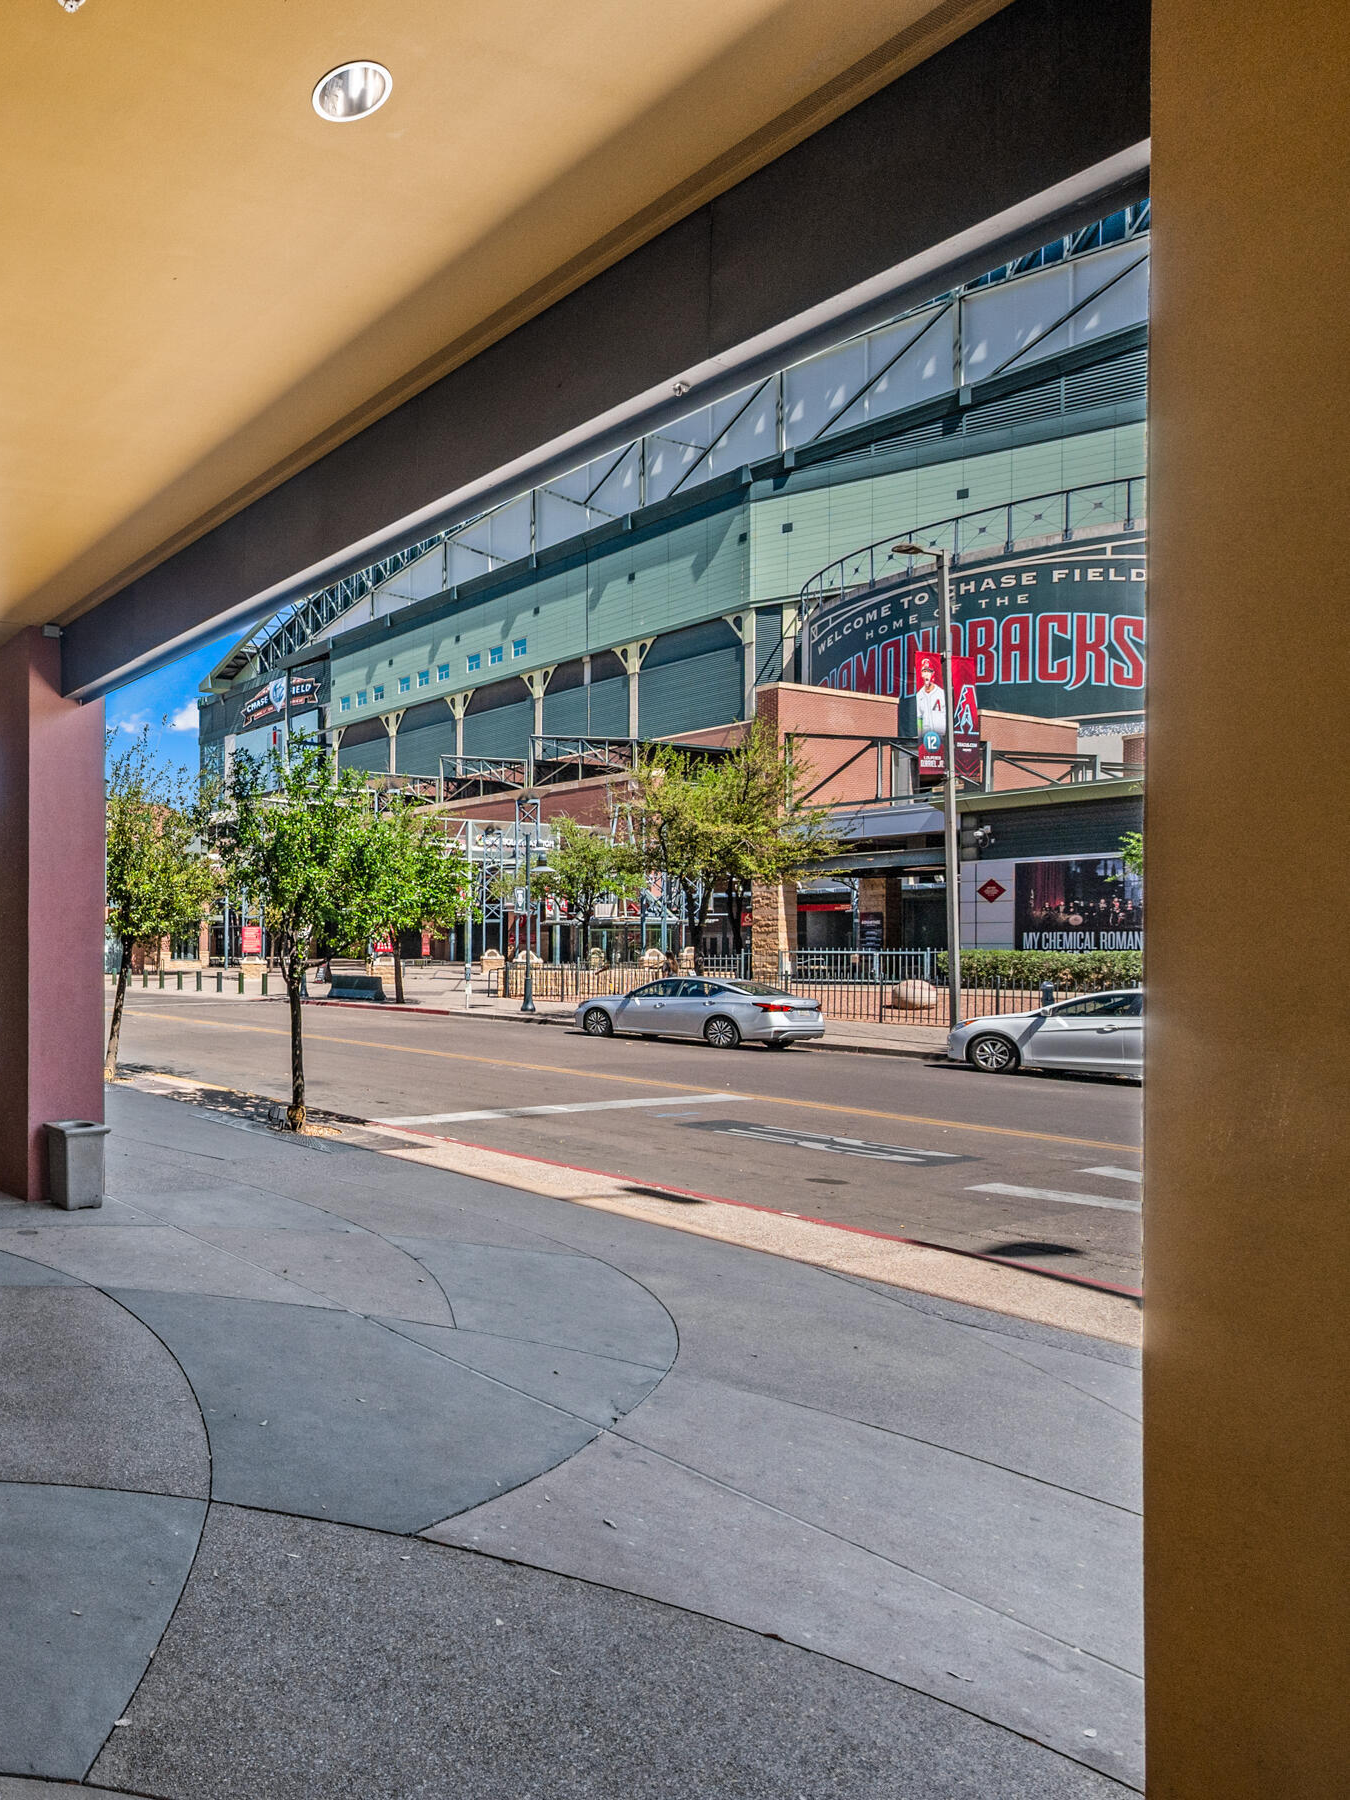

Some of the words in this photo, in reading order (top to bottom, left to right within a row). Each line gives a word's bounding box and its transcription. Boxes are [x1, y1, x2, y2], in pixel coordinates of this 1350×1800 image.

[817, 603, 892, 655] WELCOME
[901, 592, 930, 609] TO
[1052, 568, 1146, 583] FIELD
[865, 613, 919, 641] HOME
[978, 593, 1030, 609] THE
[246, 695, 269, 713] CHASE
[290, 683, 312, 695] IELD
[926, 735, 938, 750] 12
[1022, 931, 1040, 950] MY
[1041, 931, 1098, 950] CHEMICAL
